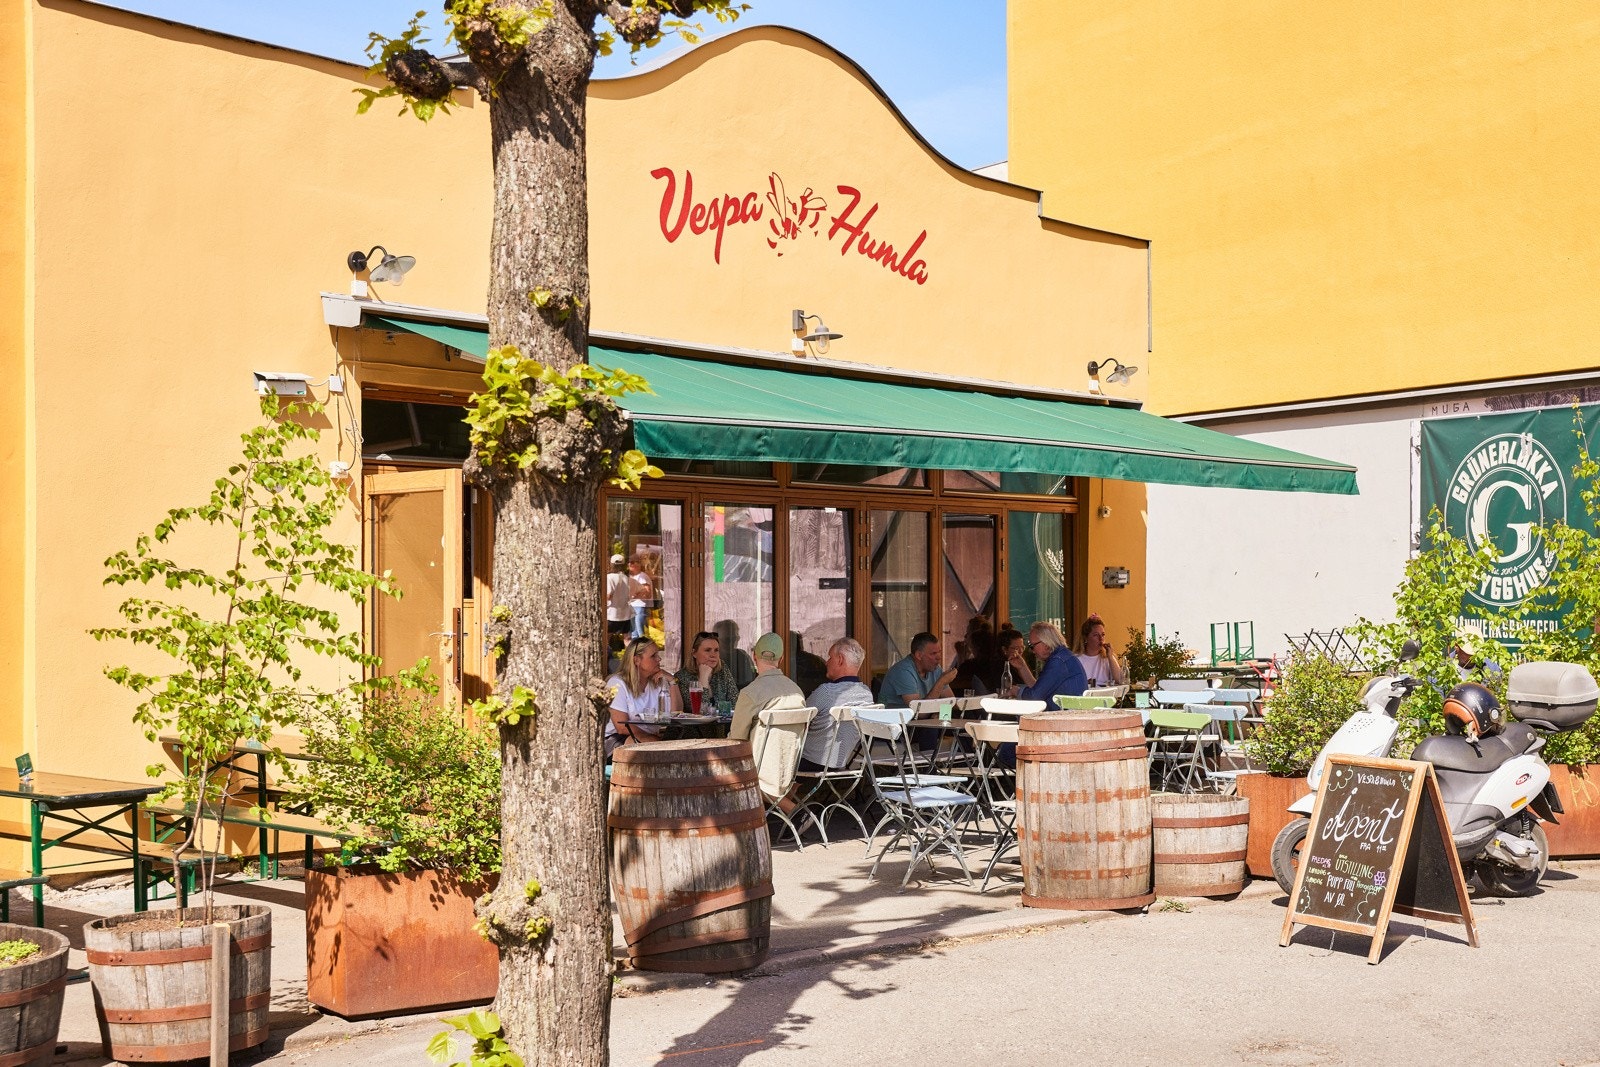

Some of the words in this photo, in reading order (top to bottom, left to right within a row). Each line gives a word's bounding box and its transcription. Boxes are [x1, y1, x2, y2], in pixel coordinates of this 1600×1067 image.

[651, 167, 763, 265] Vespa
[828, 185, 928, 285] Humla
[1431, 402, 1470, 416] MUGA
[1480, 557, 1548, 600] YGGHUS
[1335, 858, 1375, 879] UTSTILLING
